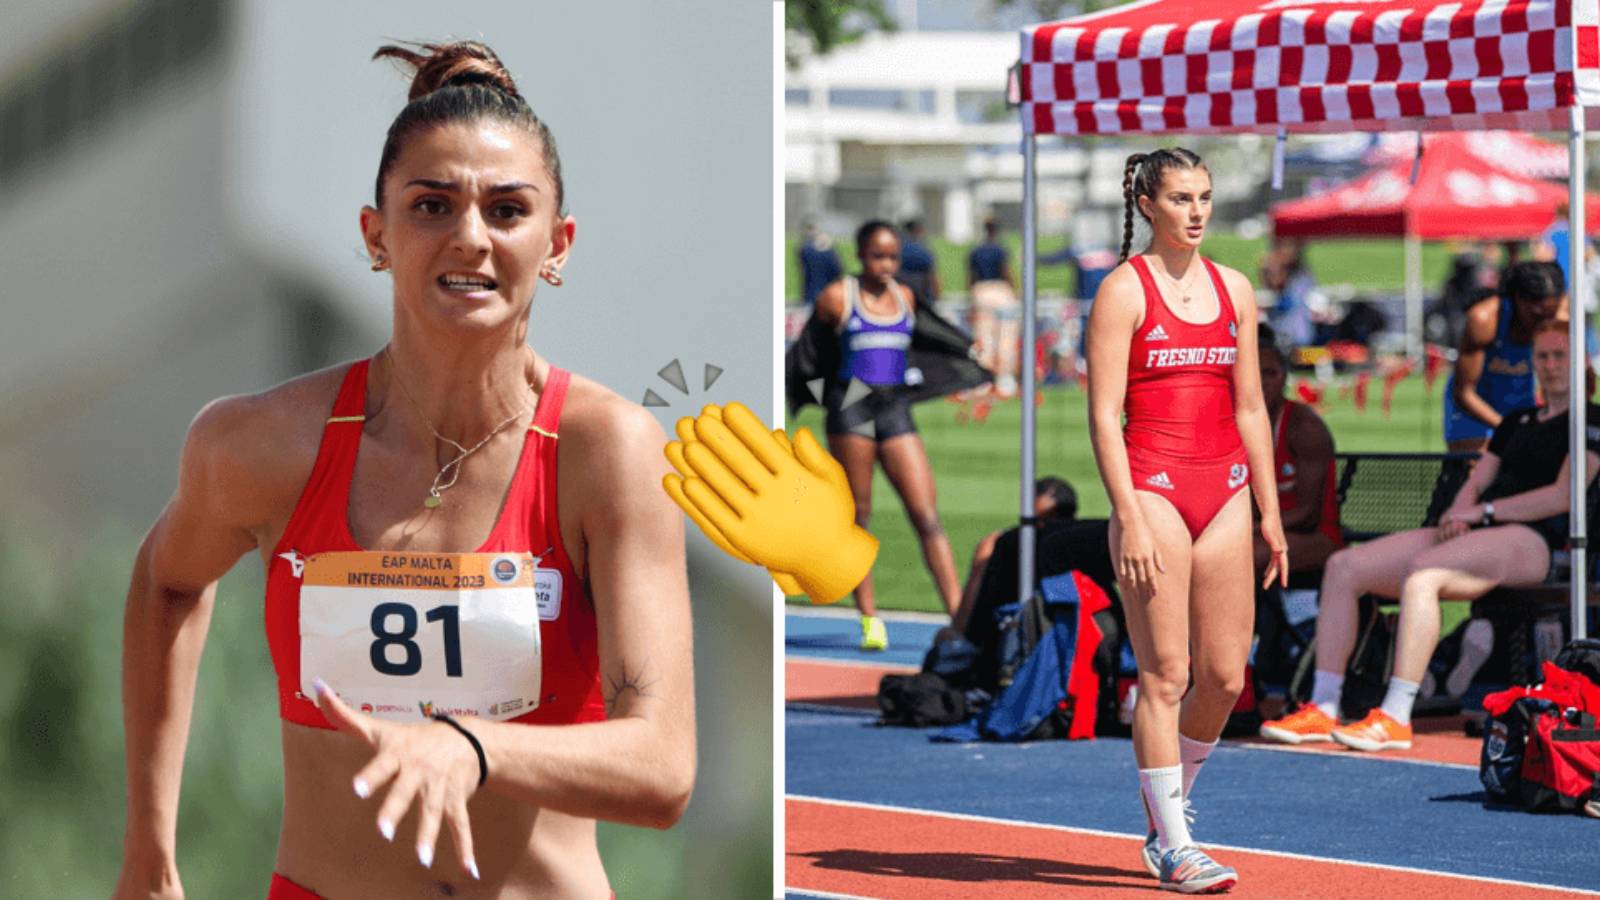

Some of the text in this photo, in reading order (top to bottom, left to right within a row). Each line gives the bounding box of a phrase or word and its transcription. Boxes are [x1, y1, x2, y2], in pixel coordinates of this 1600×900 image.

[1146, 348, 1206, 368] FRESNO
[382, 555, 453, 570] EAP MALTA
[347, 572, 485, 588] INTERNATIONAL 2023
[370, 602, 463, 677] 81
